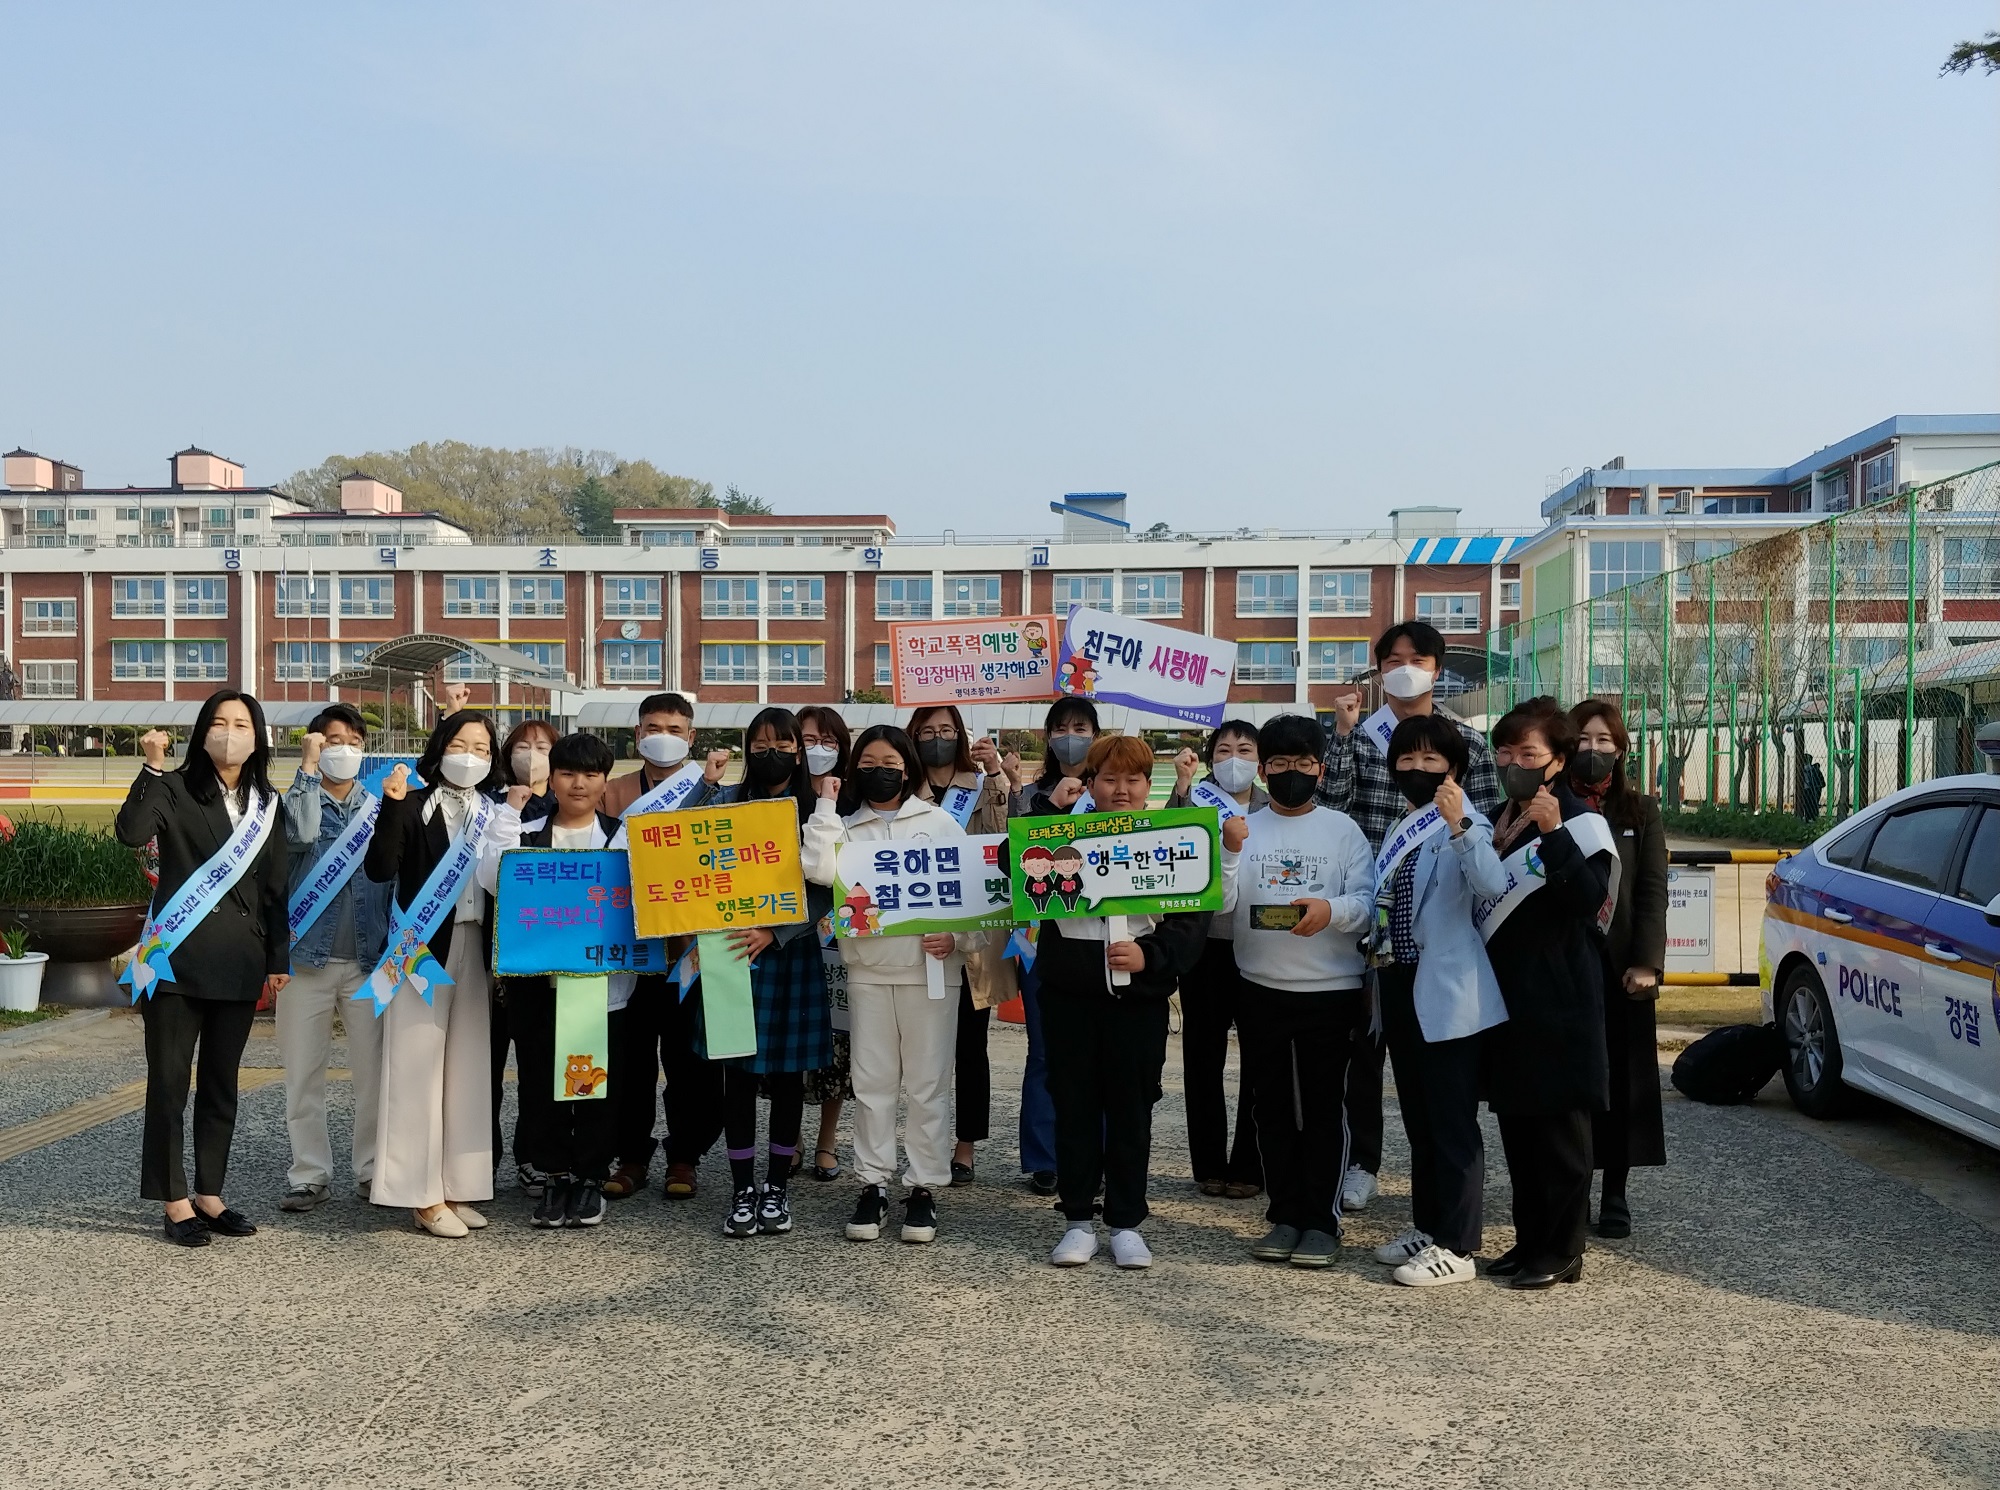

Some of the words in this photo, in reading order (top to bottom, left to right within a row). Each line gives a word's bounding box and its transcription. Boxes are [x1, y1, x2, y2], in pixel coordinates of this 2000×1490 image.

[224, 548, 241, 570] 명
[381, 547, 398, 569] 덕
[539, 548, 558, 568] 초
[700, 548, 720, 569] 등
[863, 547, 884, 568] 학
[1031, 547, 1050, 566] 교
[907, 632, 1019, 656] 학교폭력예방
[1084, 629, 1143, 670] 친구야
[661, 790, 677, 806] 함께
[234, 821, 260, 859] 마음속에
[642, 824, 682, 848] 때린
[690, 818, 733, 846] 만큼
[1028, 822, 1076, 840] 또래조정
[513, 861, 602, 885] 폭력보다
[874, 846, 960, 876] 욱하면
[1087, 844, 1151, 877] 행복한
[1153, 841, 1198, 872] 학교
[1250, 854, 1290, 862] CLASSIC
[1294, 855, 1328, 864] TENNIS
[196, 863, 231, 897] 깊어가는
[434, 871, 460, 901] 아름다운
[875, 880, 962, 910] 참으면
[985, 877, 1011, 905] 벗
[1131, 873, 1176, 891] 만들기!
[165, 895, 199, 932] 친구사랑
[417, 900, 440, 925] 사이버
[518, 906, 605, 931] 주먹보다
[585, 944, 649, 967] 대화를
[1839, 964, 1902, 1018] POLICE
[1945, 996, 1980, 1047] 경찰
